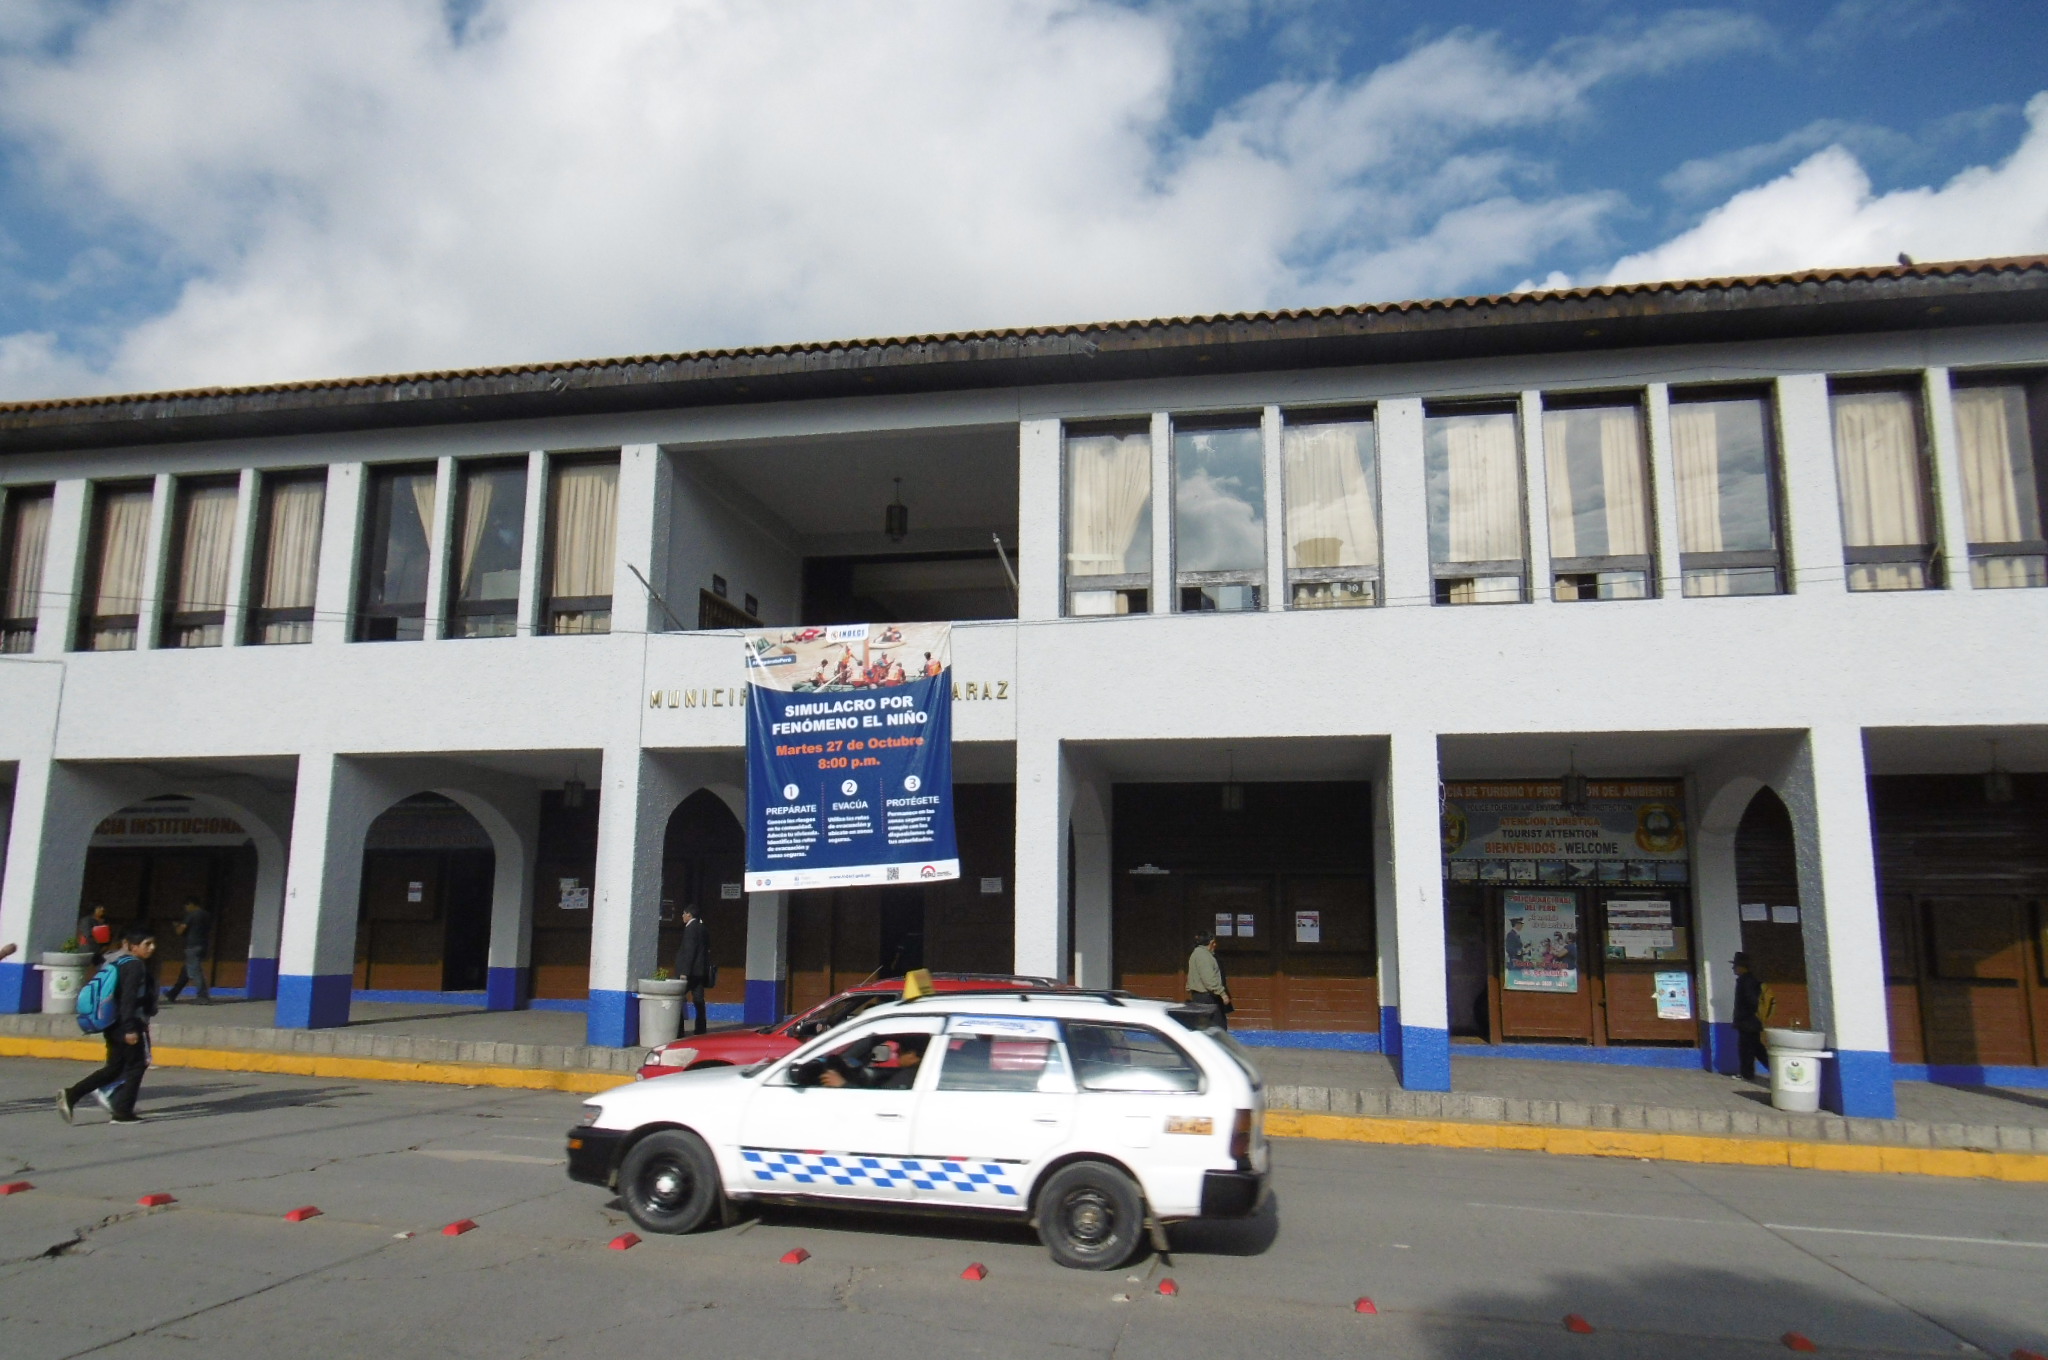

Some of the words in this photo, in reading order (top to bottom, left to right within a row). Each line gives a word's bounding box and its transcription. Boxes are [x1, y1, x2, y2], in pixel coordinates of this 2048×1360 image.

[785, 699, 876, 717] SIMULACRO
[880, 695, 914, 709] POR
[772, 717, 858, 735] FENÓMENO
[863, 715, 882, 727] EL
[887, 710, 928, 726] NIÑO
[776, 743, 823, 756] Martes
[827, 740, 843, 752] 27
[847, 739, 864, 751] de
[868, 736, 924, 749] Octubre
[818, 757, 848, 769] 8:00
[851, 758, 881, 770] p.m.
[1465, 785, 1478, 797] DE
[1480, 785, 1524, 797] TURISMO
[1526, 785, 1534, 797] Y
[1601, 785, 1620, 797] DEL
[1623, 785, 1675, 797] AMBIENTE
[832, 799, 868, 811] EVACÚA
[886, 795, 940, 807] PROTÉGETE
[766, 804, 817, 815] PREPÁRATE
[130, 817, 246, 834] INSTITUCIONA
[1503, 829, 1543, 838] TOURIST
[1545, 829, 1599, 838] ATTENTION
[1485, 842, 1556, 854] BIENVENIDOS
[1565, 842, 1619, 854] WELCOME
